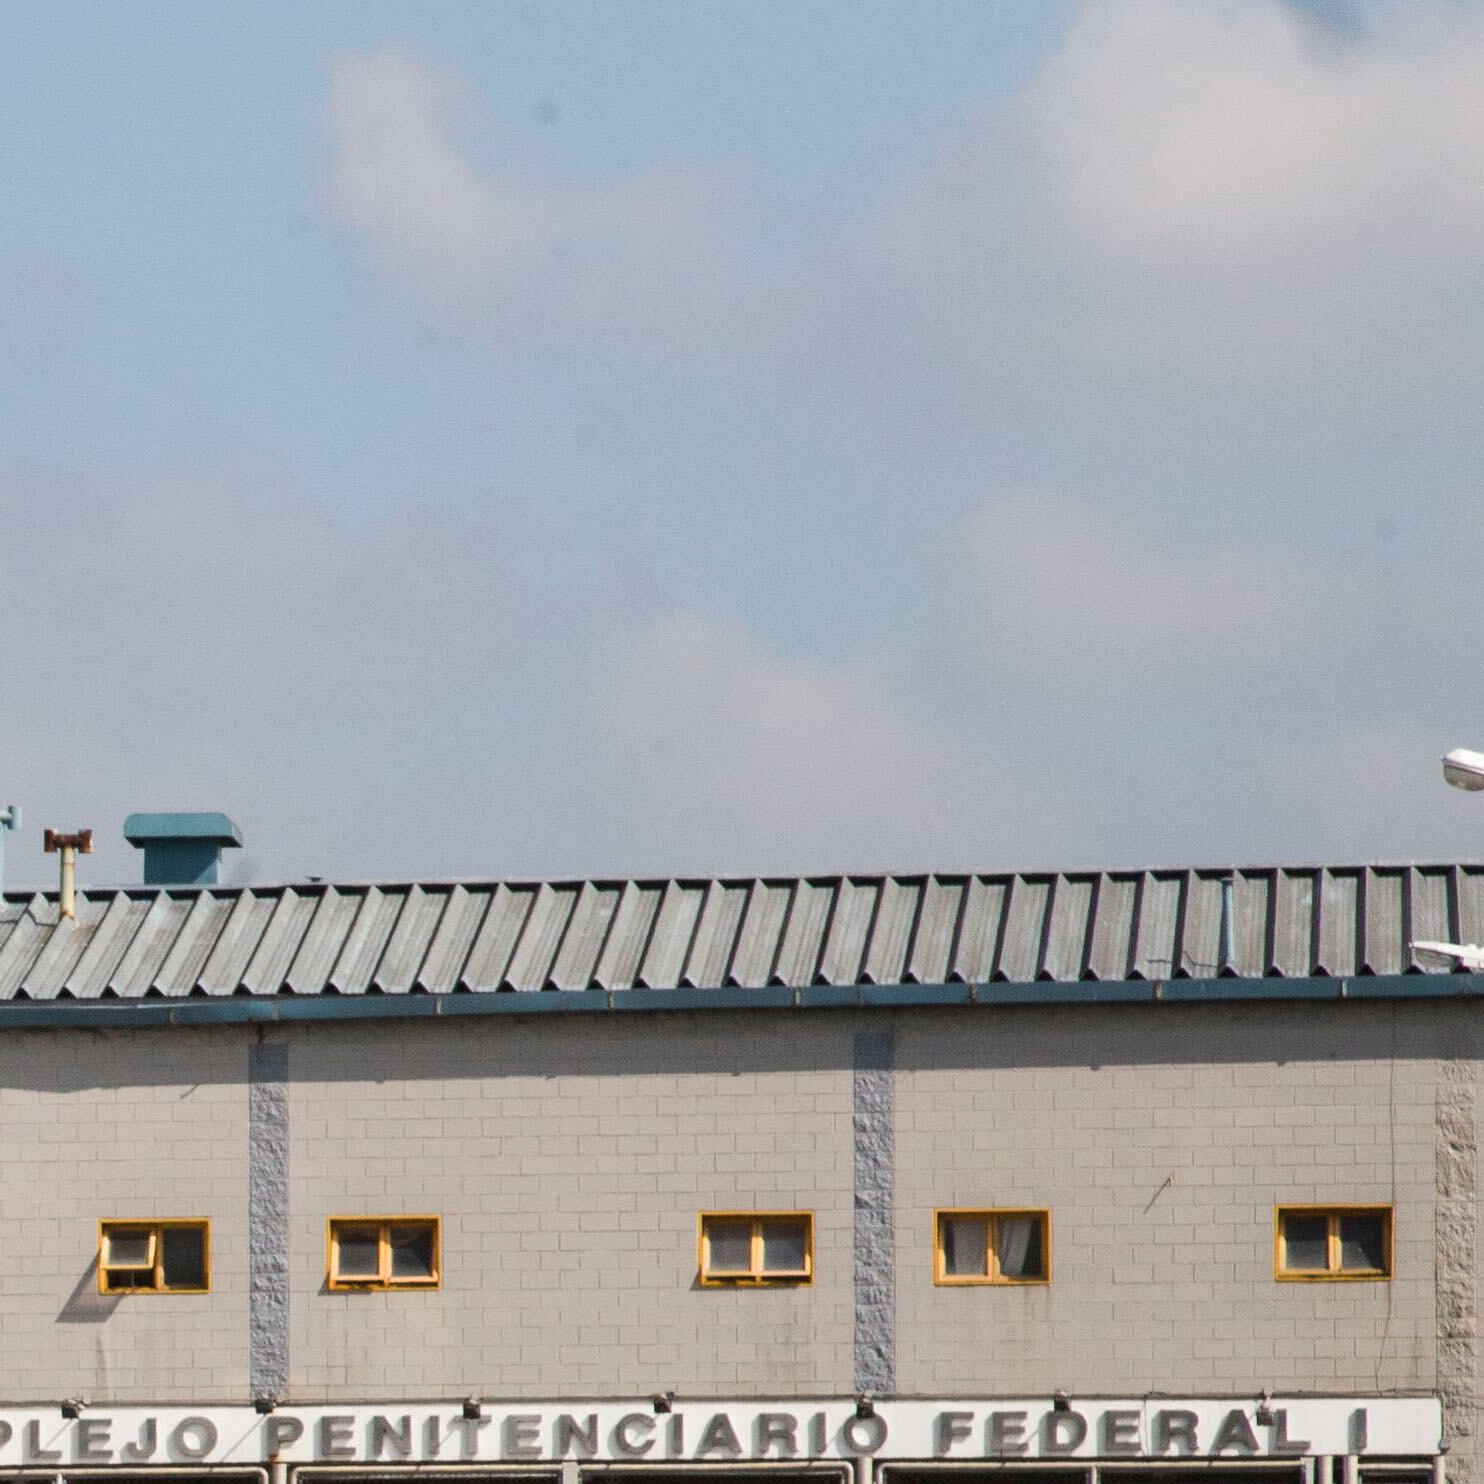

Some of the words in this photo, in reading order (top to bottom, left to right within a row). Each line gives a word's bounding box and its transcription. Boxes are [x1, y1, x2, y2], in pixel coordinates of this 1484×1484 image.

[264, 1409, 889, 1459] PENITENCIARIO
[933, 1407, 1312, 1455] FEDERAL
[1348, 1407, 1368, 1452] I
